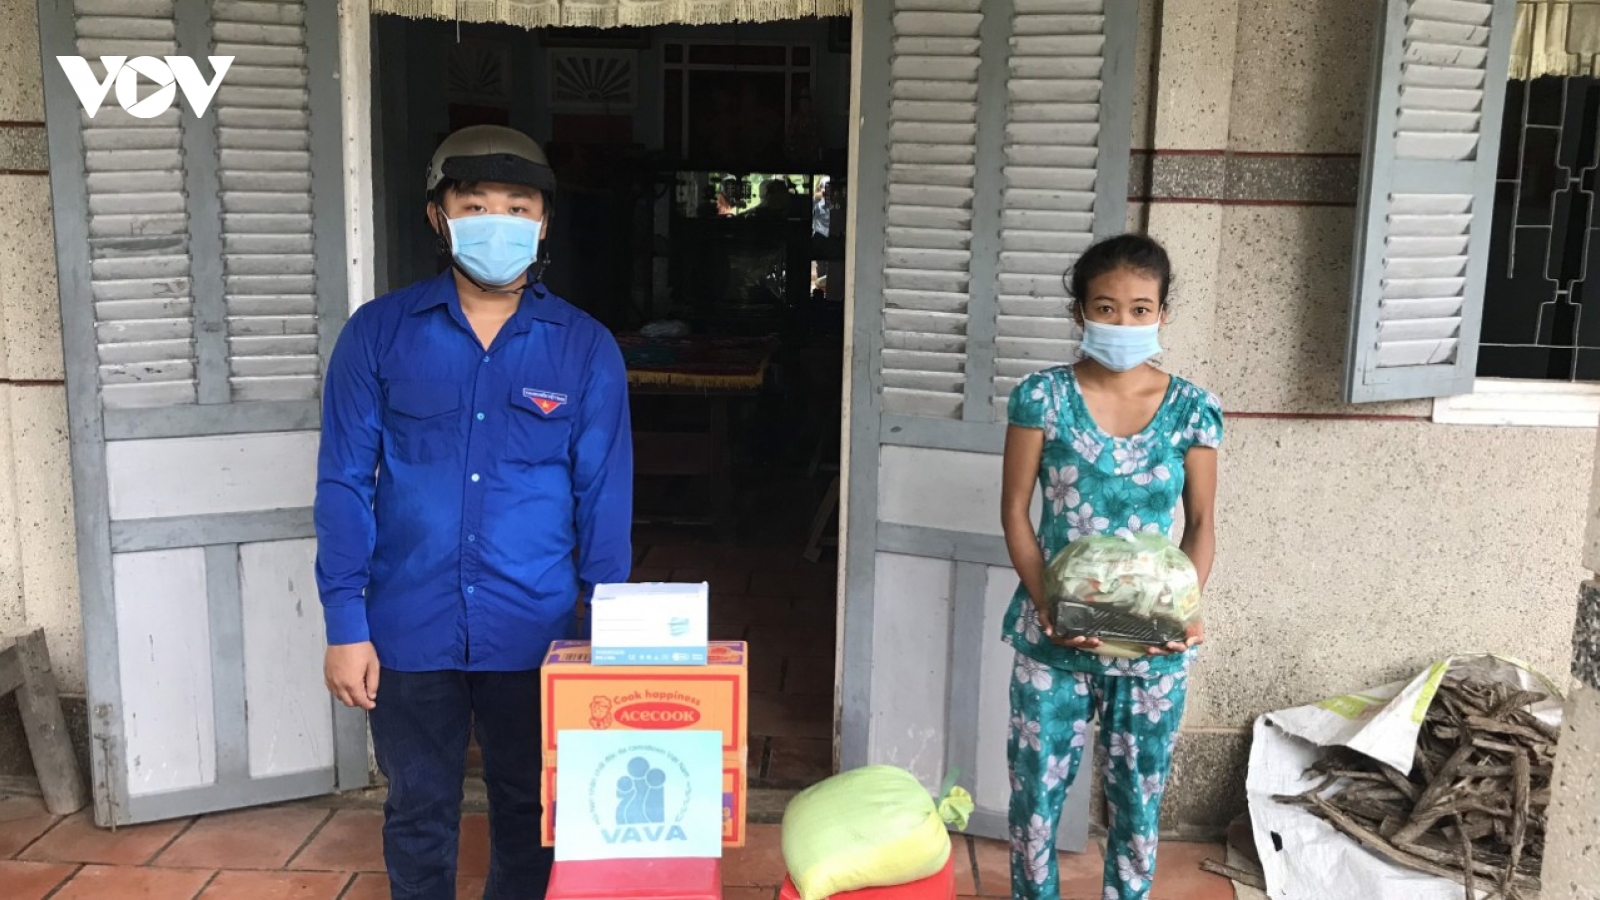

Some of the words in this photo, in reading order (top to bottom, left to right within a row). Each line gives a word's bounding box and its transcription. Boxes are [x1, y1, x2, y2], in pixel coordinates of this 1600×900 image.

[613, 691, 642, 705] Cook
[645, 690, 700, 705] happiness
[602, 825, 687, 843] VAVA
